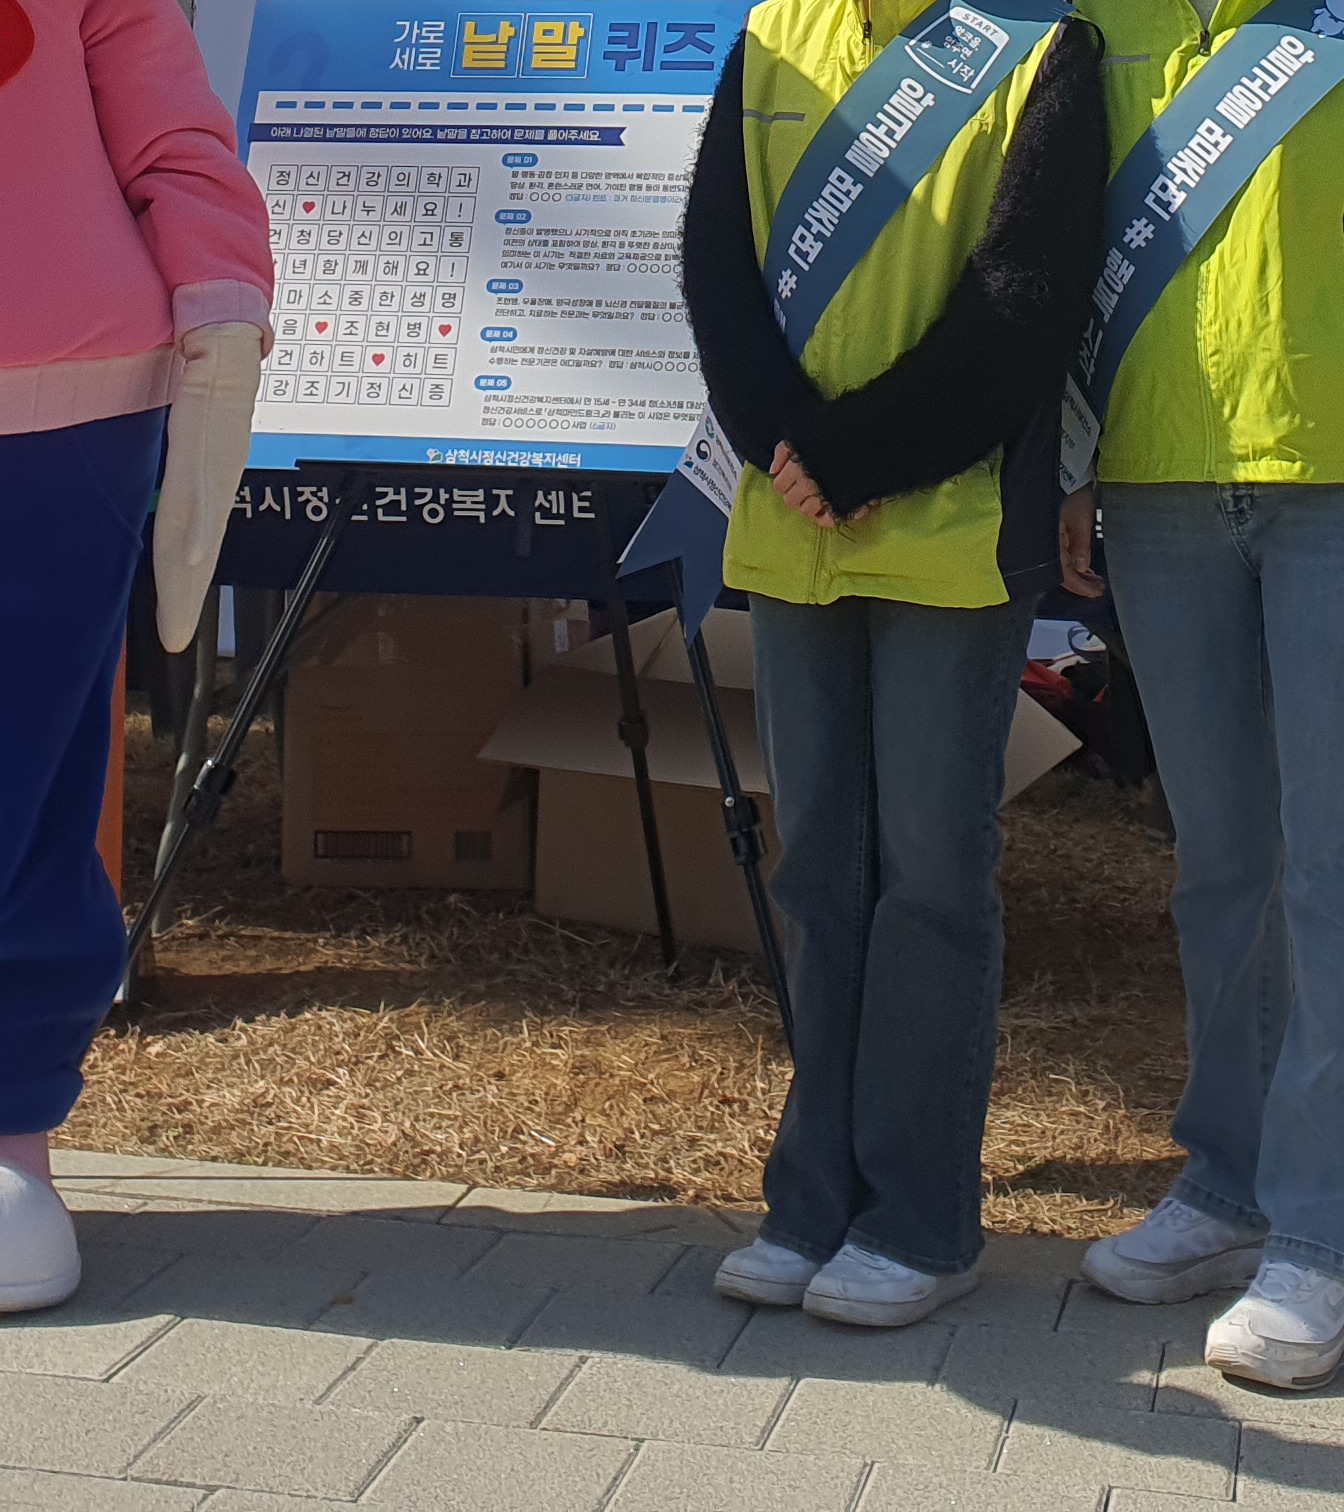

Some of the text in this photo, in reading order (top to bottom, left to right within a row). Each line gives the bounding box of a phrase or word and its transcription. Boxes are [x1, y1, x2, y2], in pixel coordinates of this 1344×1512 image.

[393, 21, 445, 44] 가로
[960, 10, 1000, 39] START
[389, 47, 441, 71] 세로
[602, 22, 717, 72] 퀴즈
[946, 56, 976, 84] 시작
[1216, 34, 1316, 130] 알코올
[844, 76, 936, 178] 알코올
[1144, 118, 1232, 221] 멈추면
[786, 164, 865, 273] 멈추면
[445, 448, 582, 468] 삼척시정신건강복지센터
